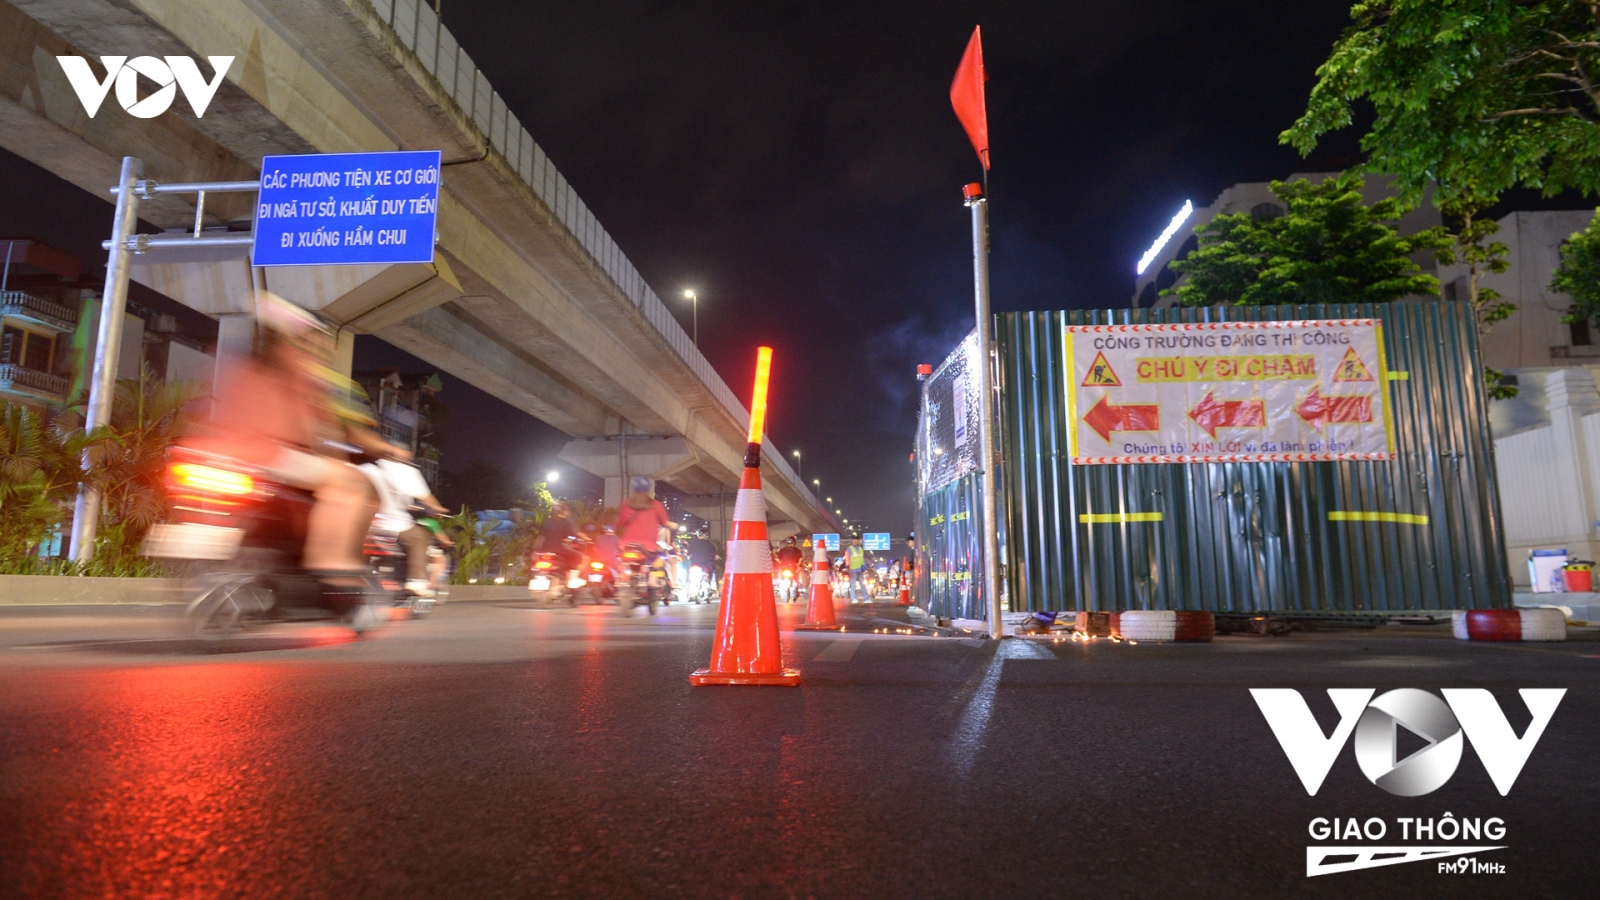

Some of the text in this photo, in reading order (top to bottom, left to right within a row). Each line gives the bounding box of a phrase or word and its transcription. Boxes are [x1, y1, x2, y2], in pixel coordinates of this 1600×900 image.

[263, 165, 436, 188] CÁC PHƯƠNG TIỆN XE CƠ GIỚI
[260, 193, 436, 218] ĐI NGÃ TƯ SỞ, KHUẤT DUY TIẾN
[281, 225, 406, 248] ĐI XUỐNG HẦM CHUI
[1094, 330, 1350, 350] CÔNG TRƯỜNG ĐANG THI CÔNG
[1137, 356, 1316, 380] CHÚ Ý ĐI CHẬM
[1124, 443, 1166, 456] Chúng
[1170, 442, 1187, 454] tôi
[1192, 442, 1214, 454] XIN
[1281, 441, 1304, 452] làm
